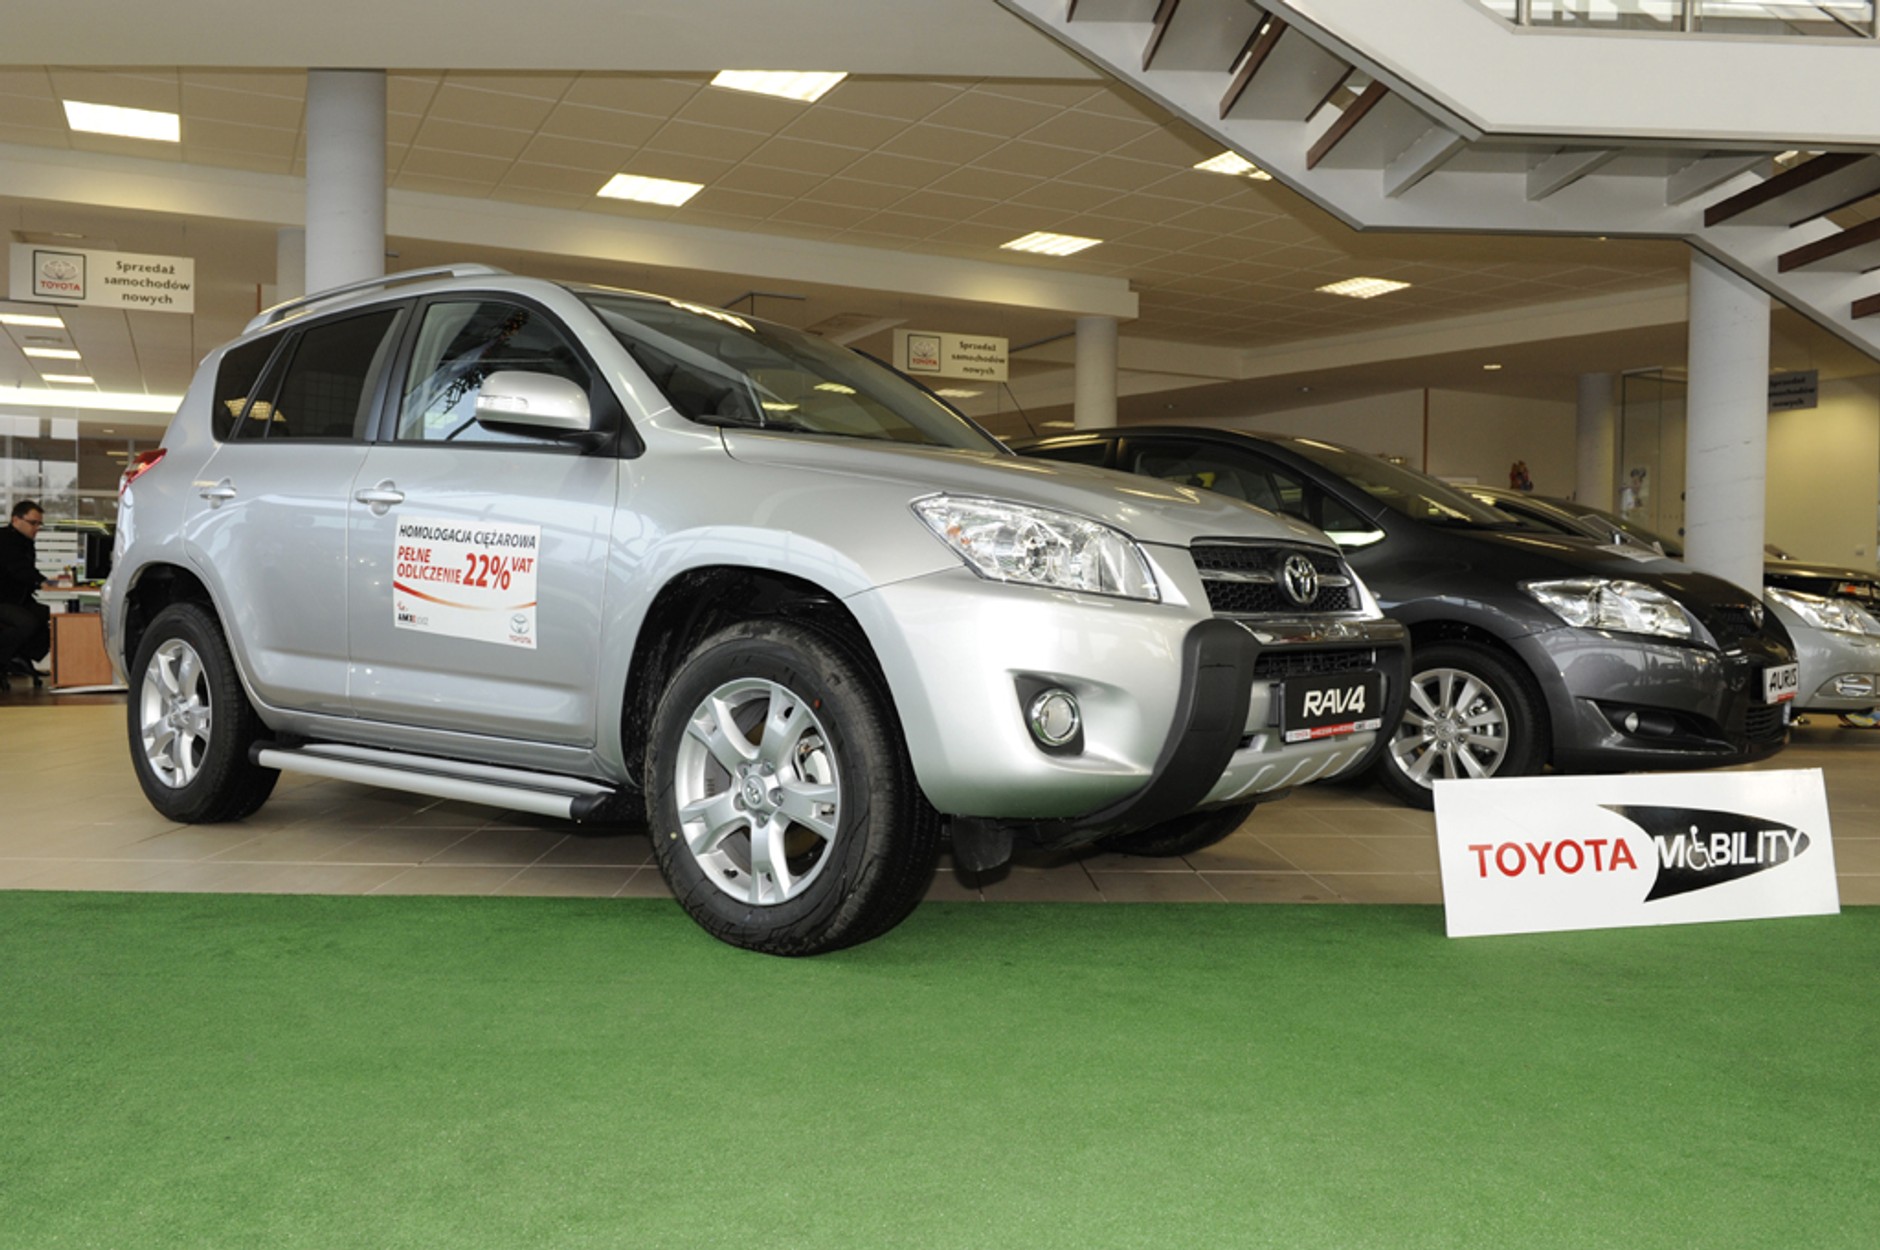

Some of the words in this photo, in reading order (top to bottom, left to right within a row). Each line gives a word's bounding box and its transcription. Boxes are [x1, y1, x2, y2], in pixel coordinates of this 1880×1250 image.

[115, 260, 175, 275] Sprzedaż
[40, 280, 81, 292] TOYOTA
[104, 275, 191, 291] samochodów
[121, 292, 173, 305] nowych
[912, 357, 938, 366] TOYOTA
[962, 366, 995, 376] nowych
[399, 524, 472, 543] HOMOLOGACJA
[474, 530, 536, 549] CIĘŻAROWA
[397, 546, 431, 563] PEŁNE
[397, 563, 462, 584] ODLICZENIE
[463, 552, 511, 590] 22%
[511, 556, 534, 574] VAT
[1302, 685, 1366, 718] RAV4
[1468, 838, 1638, 878] TOYOTA
